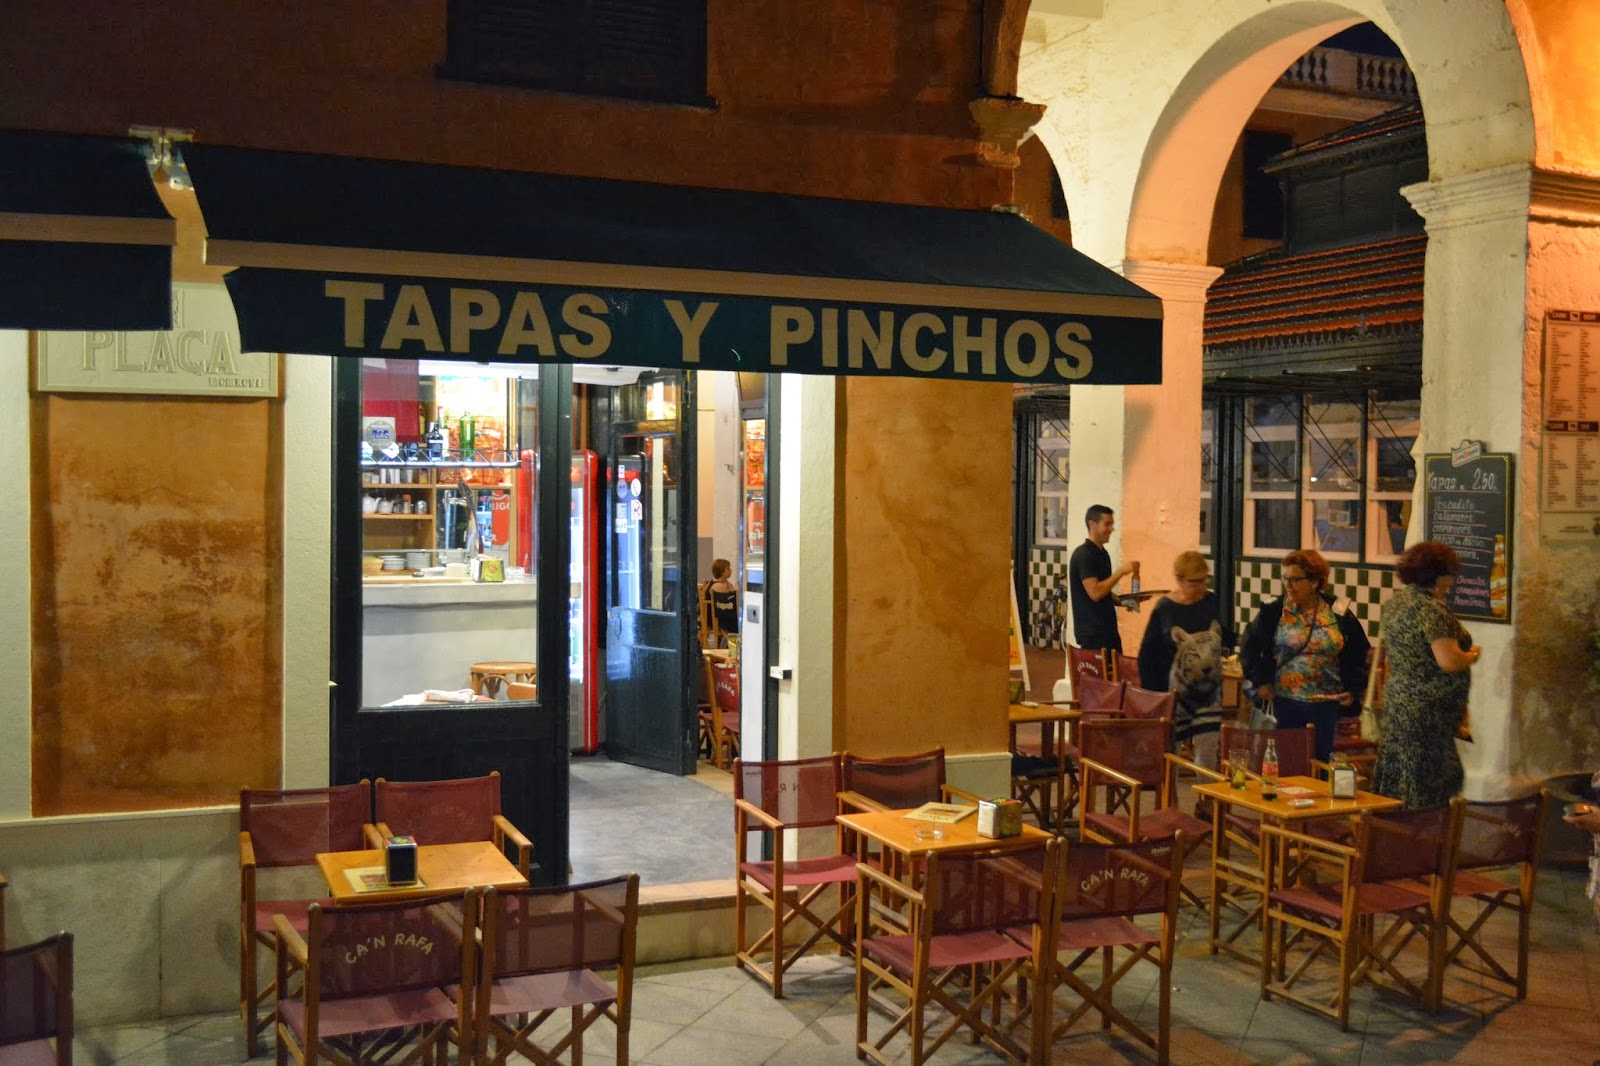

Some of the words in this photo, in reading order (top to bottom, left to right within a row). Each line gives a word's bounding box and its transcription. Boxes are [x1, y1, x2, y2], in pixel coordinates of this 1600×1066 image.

[325, 280, 612, 358] TAPAS
[663, 299, 719, 363] Y
[770, 305, 1094, 379] PINCHOS
[1081, 868, 1114, 891] CA'N
[1120, 867, 1150, 888] RAFA
[345, 934, 386, 964] CA'N
[394, 932, 434, 956] RAFA
